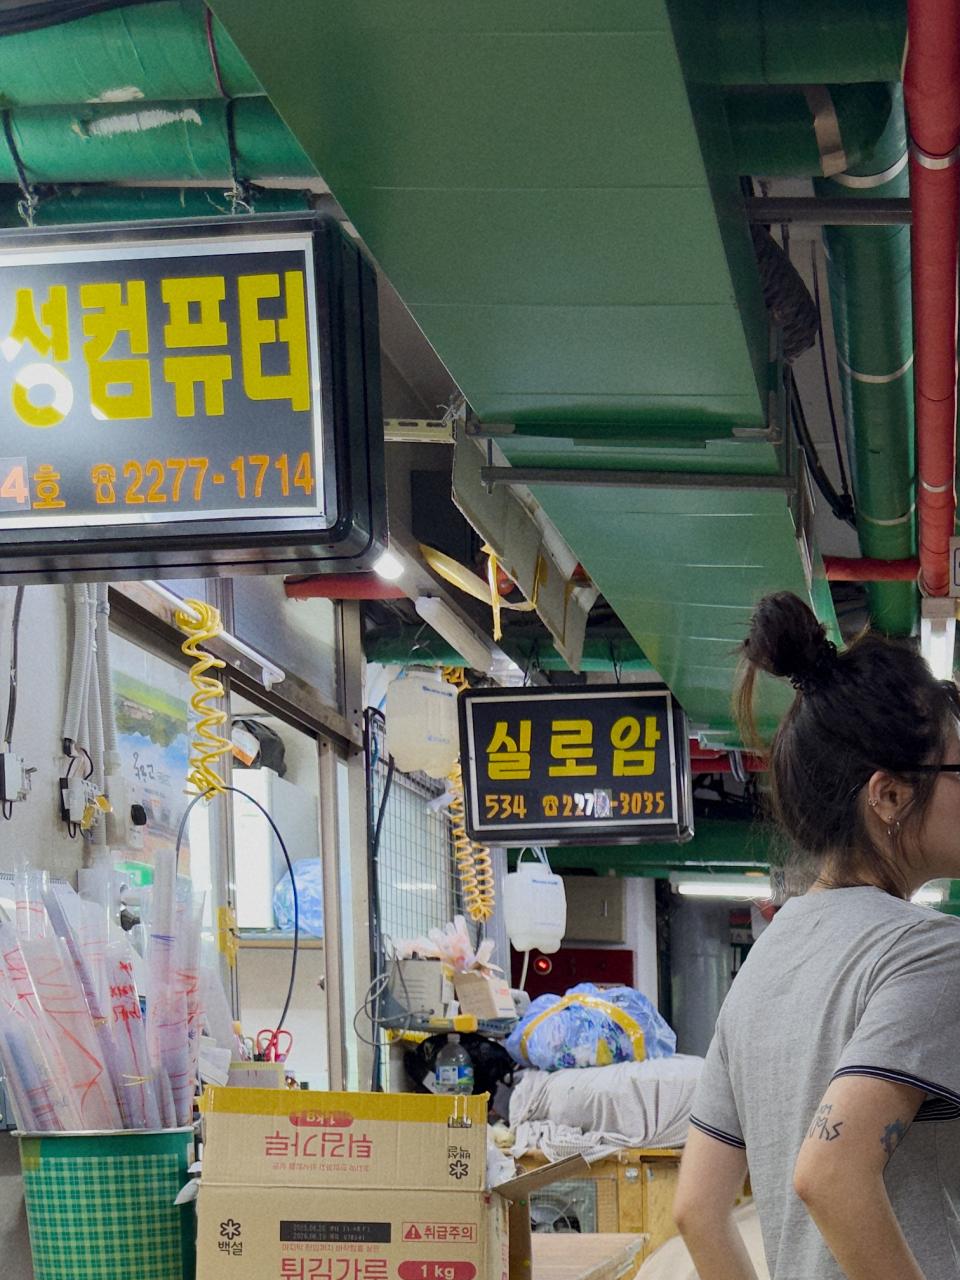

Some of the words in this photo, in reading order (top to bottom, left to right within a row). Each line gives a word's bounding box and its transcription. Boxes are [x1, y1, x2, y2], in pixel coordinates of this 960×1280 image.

[2, 270, 311, 428] 성컴퓨터
[123, 452, 314, 504] 2277-1714
[486, 716, 661, 780] 실로암
[485, 794, 527, 819] 534
[264, 1131, 373, 1158] 튀김가루
[424, 1224, 473, 1241] 취급주의
[217, 1240, 243, 1256] 백설
[434, 1263, 455, 1280] kg
